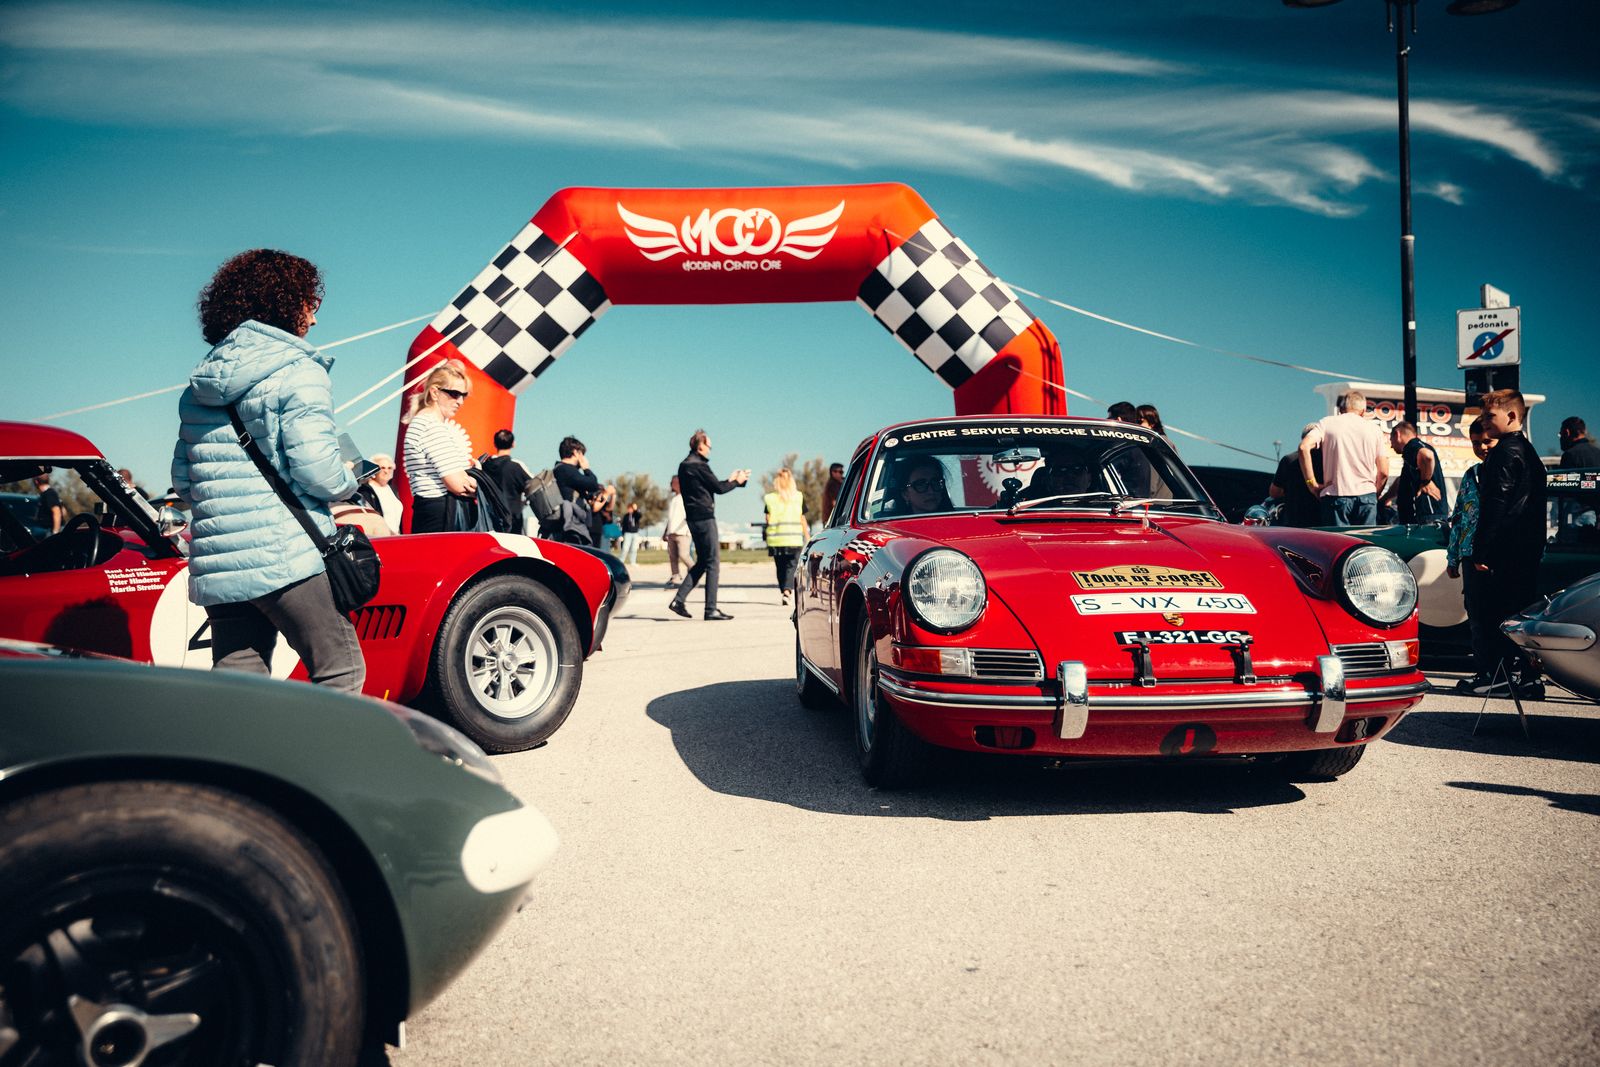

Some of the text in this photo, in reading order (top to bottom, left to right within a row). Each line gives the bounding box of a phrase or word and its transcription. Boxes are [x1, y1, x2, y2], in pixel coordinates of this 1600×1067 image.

[1467, 321, 1509, 330] pedonale
[903, 429, 956, 443] CENTRE
[961, 427, 1019, 436] SERVICE
[1024, 427, 1087, 436] PORSCHE
[1091, 429, 1151, 444] LIMOGES
[1079, 573, 1127, 583] TOUR
[1156, 572, 1213, 583] CORSE
[1081, 599, 1101, 611] S
[1130, 597, 1182, 609] WX
[1197, 597, 1245, 610] 450
